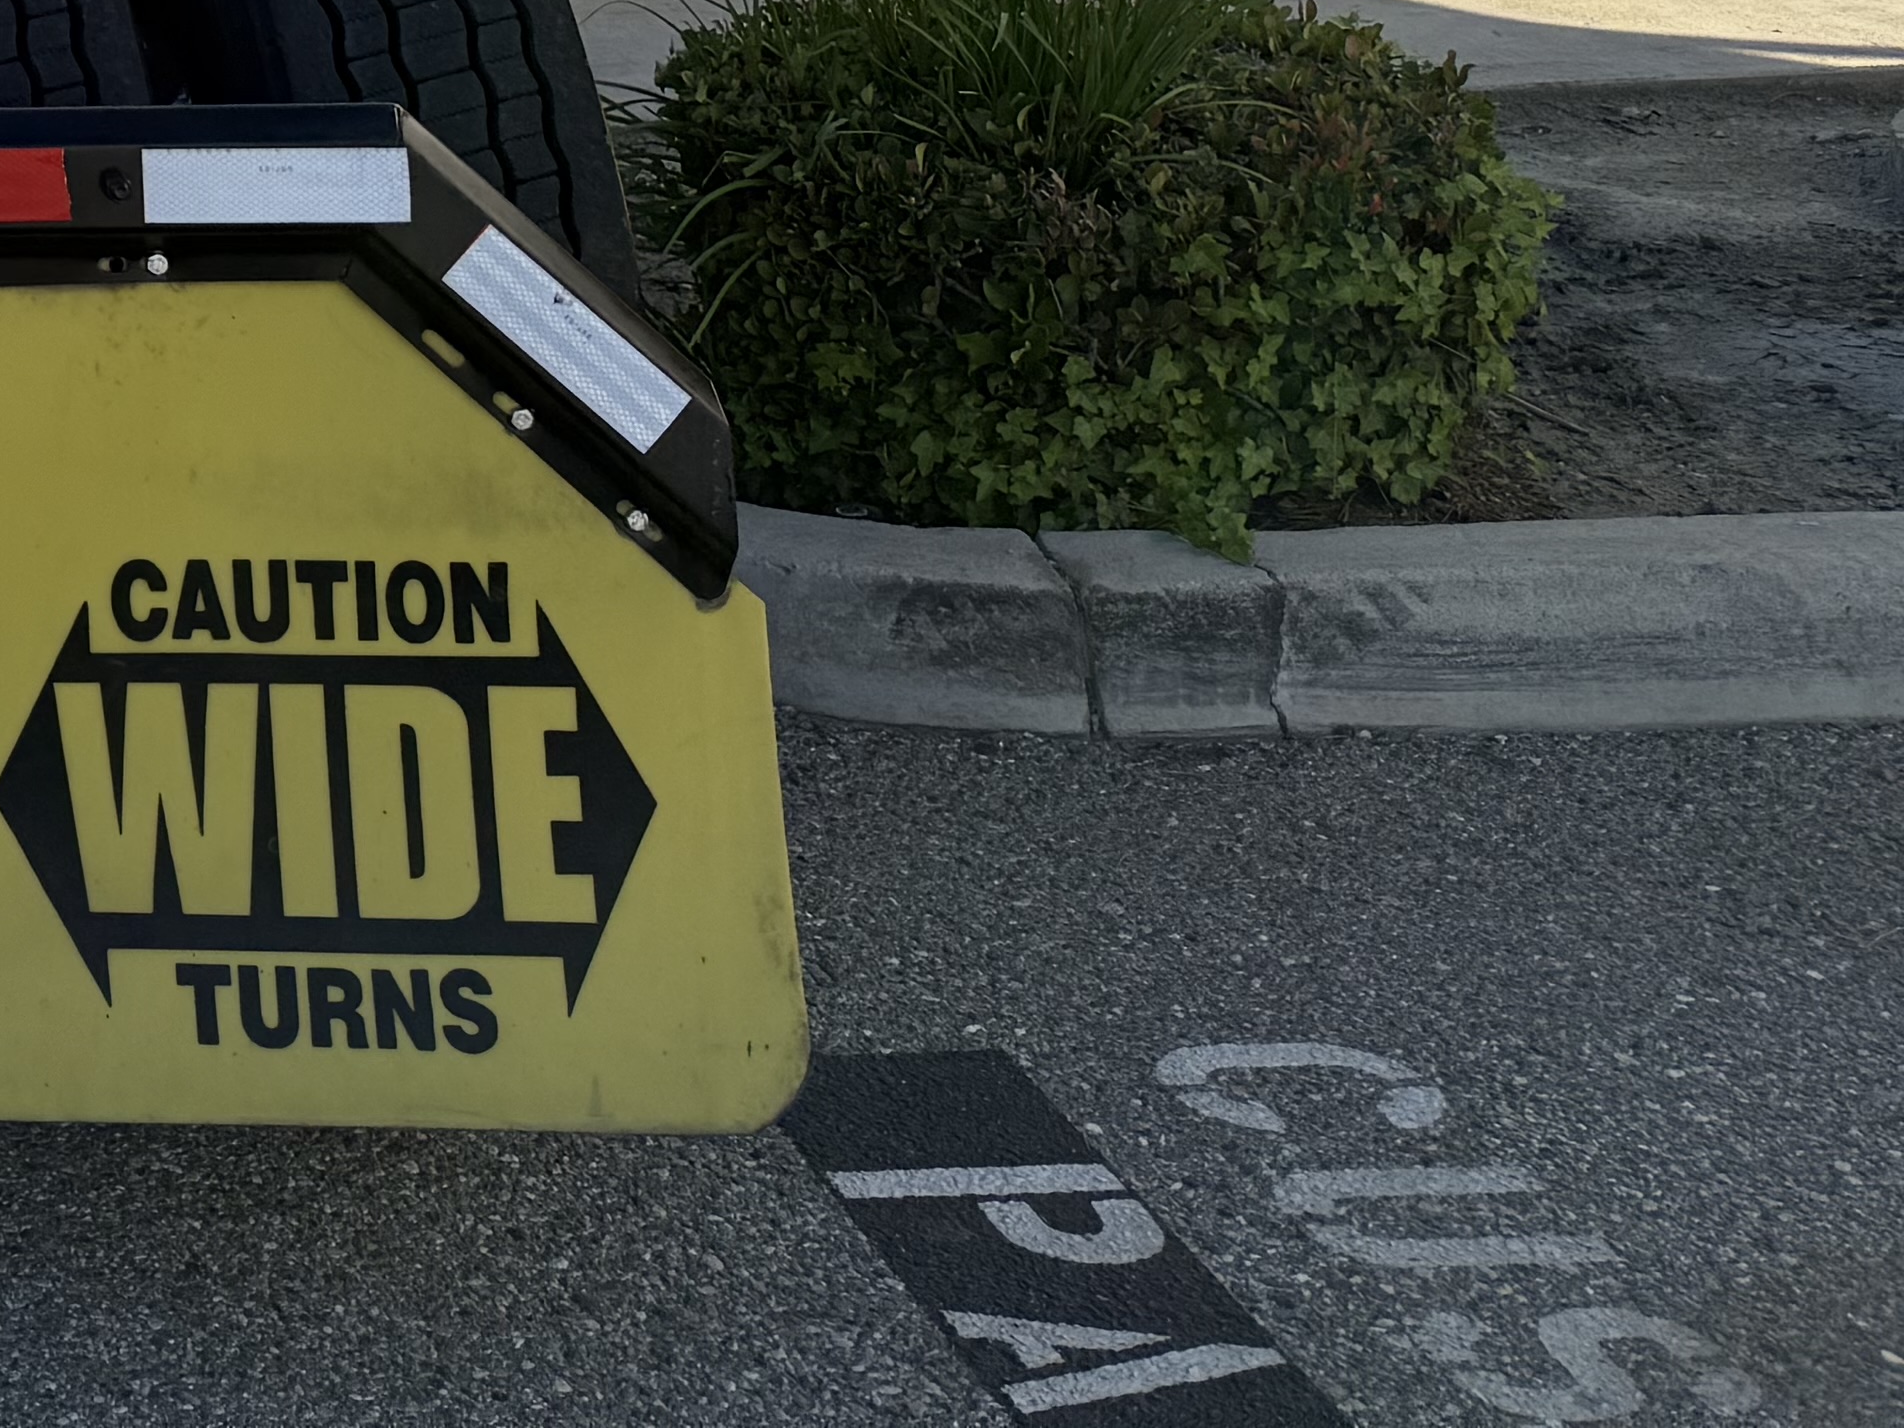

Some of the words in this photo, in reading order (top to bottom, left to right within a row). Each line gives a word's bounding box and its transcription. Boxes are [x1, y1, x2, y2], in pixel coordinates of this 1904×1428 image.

[109, 558, 512, 645] CAUTION
[52, 680, 599, 925] WIDE
[175, 961, 499, 1055] TURNS
